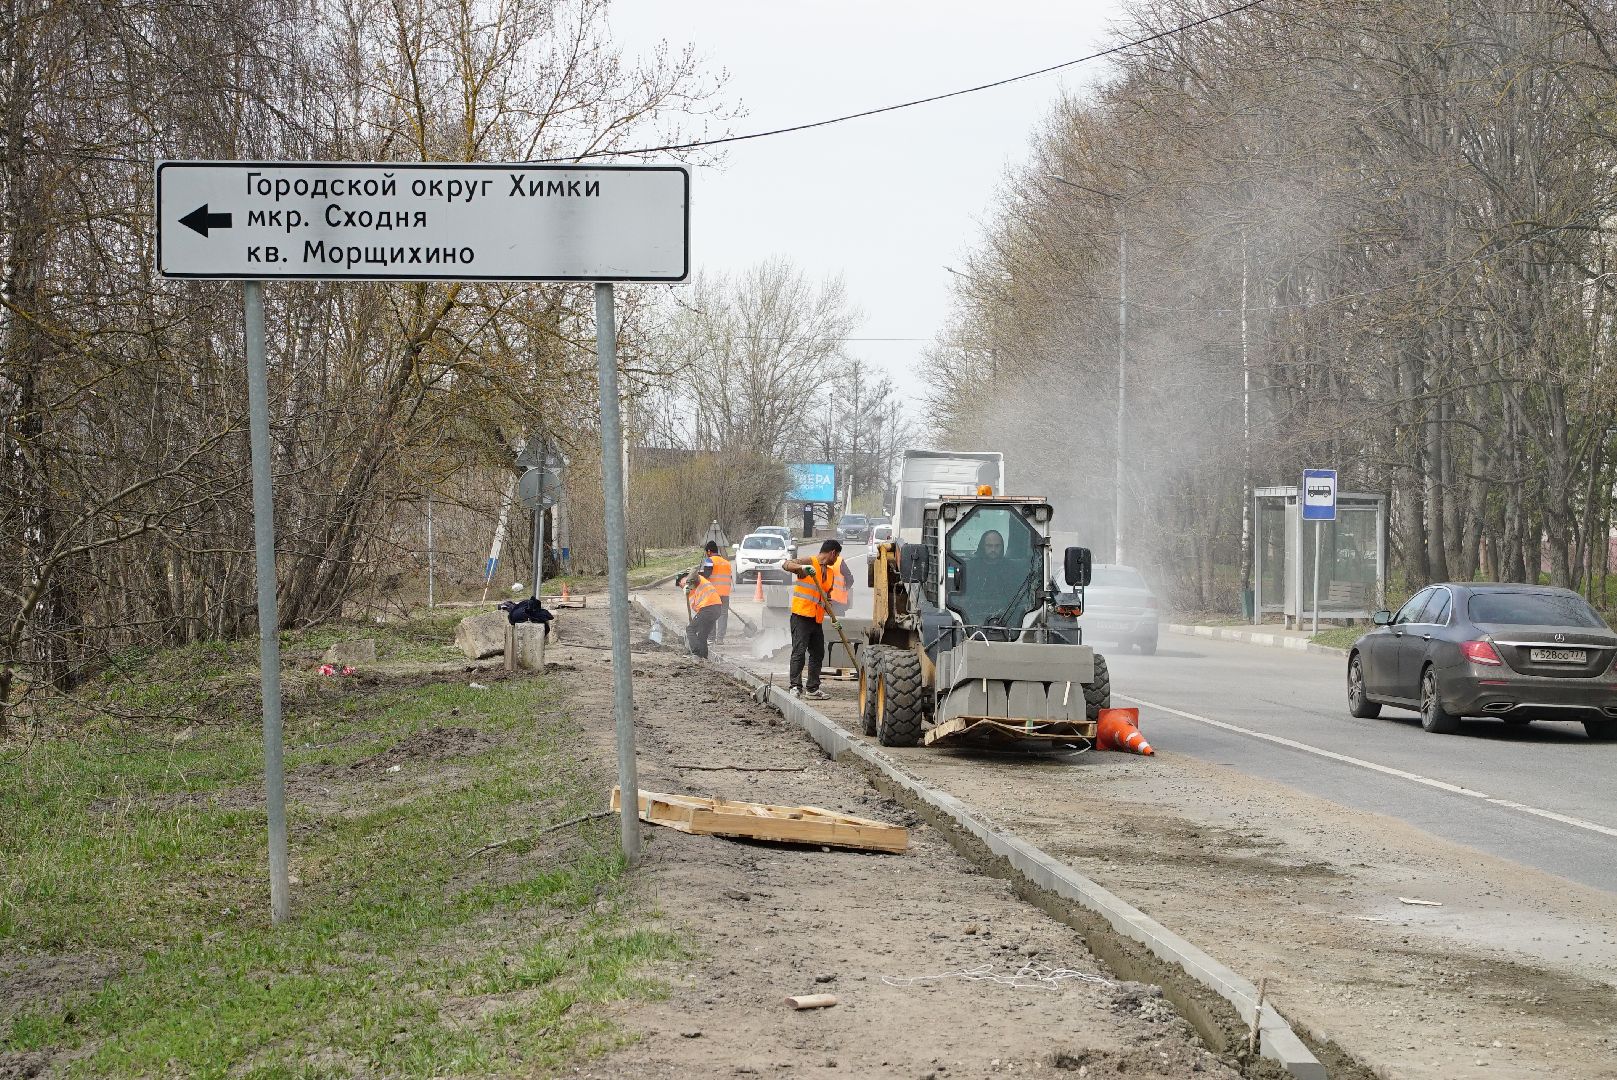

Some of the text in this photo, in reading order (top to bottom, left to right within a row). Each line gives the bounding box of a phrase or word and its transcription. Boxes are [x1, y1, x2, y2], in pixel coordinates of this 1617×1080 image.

[246, 173, 602, 203] Городской округ Химки
[246, 203, 428, 234] мкр. Сходня
[246, 241, 475, 270] кв. Морщихино
